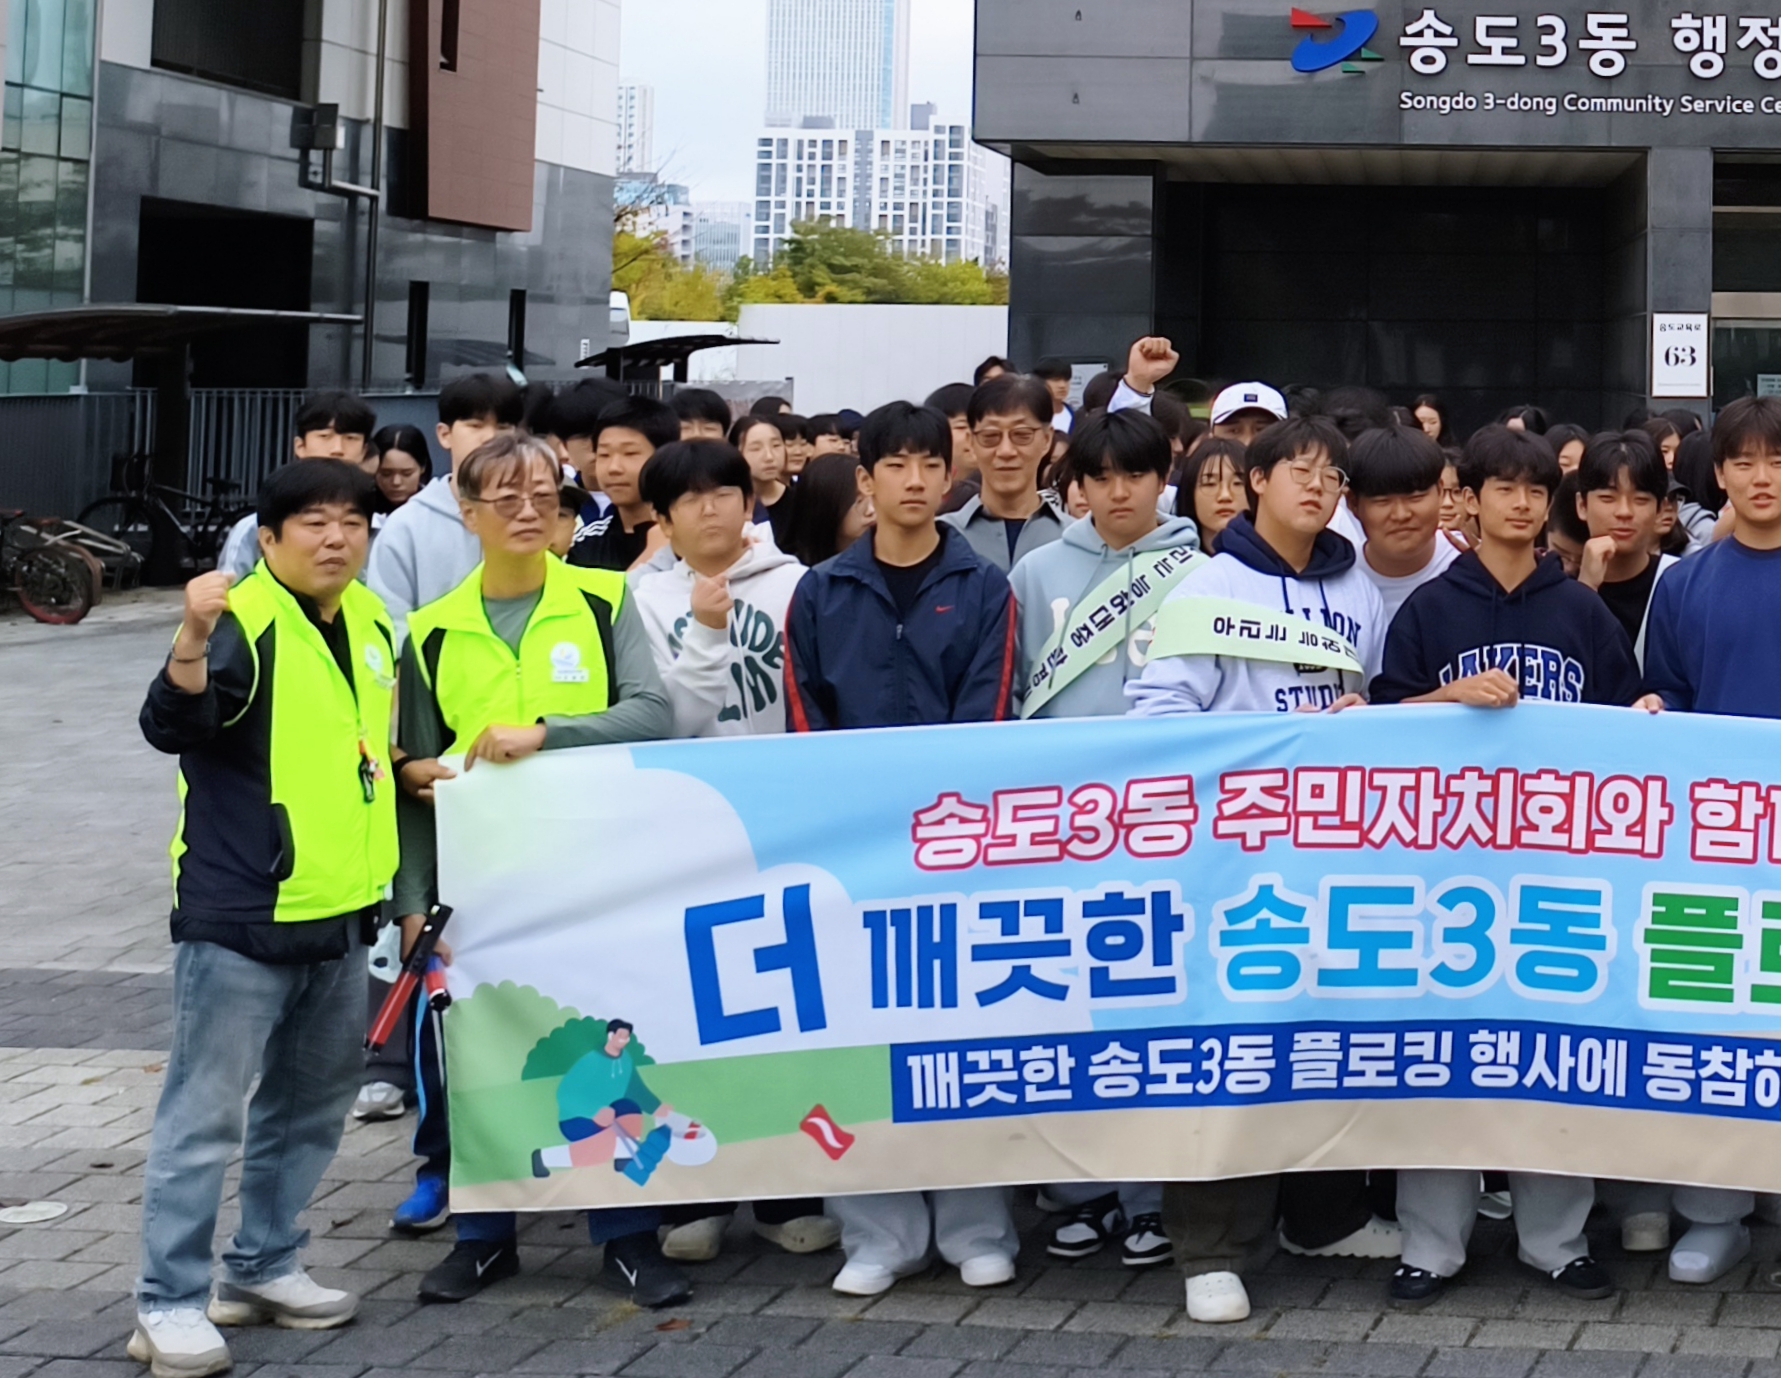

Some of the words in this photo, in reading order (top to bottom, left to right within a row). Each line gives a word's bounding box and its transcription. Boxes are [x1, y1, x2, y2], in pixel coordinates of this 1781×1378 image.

[1399, 9, 1638, 77] 송도3동
[1400, 92, 1477, 114] Songdo
[1483, 93, 1557, 115] 3-dong
[1563, 94, 1674, 117] Community
[1680, 96, 1754, 115] Service
[1664, 345, 1697, 367] 63
[1213, 616, 1287, 642] 우리는
[912, 774, 1197, 871] 송도3동
[1213, 764, 1672, 860] 주민자치회와
[684, 883, 827, 1046] 더
[862, 889, 1184, 1011] 깨끗한
[1219, 882, 1607, 994] 송도3동
[907, 1043, 1076, 1110] 깨끗한
[1088, 1032, 1277, 1097] 송도3동
[1288, 1031, 1455, 1088] 플로킹
[1469, 1030, 1629, 1097] 행사에
